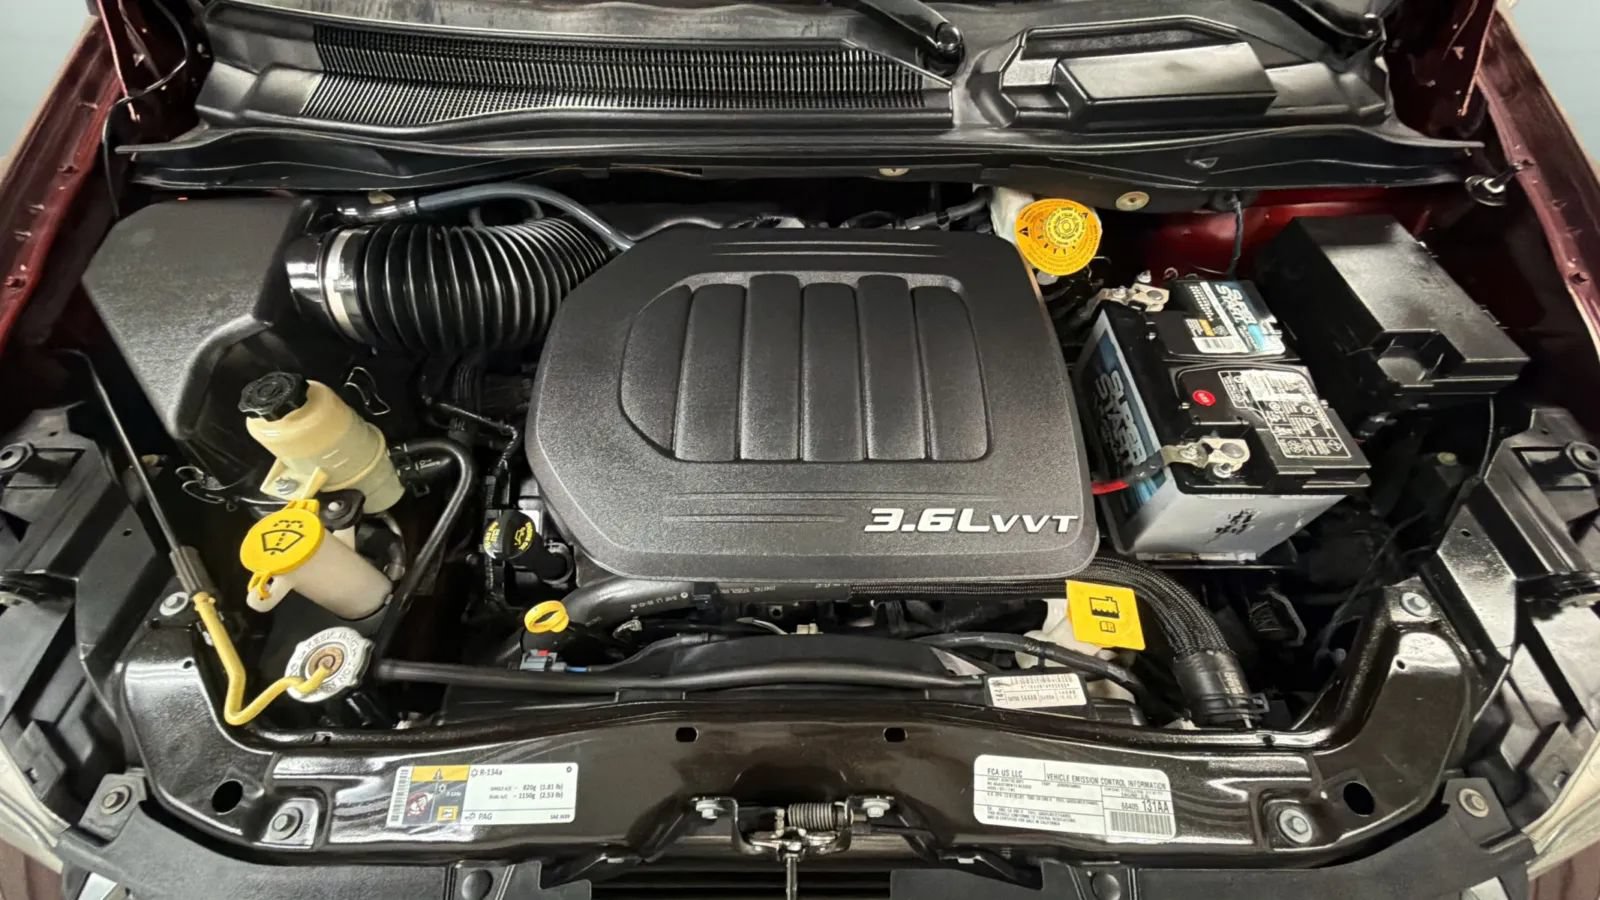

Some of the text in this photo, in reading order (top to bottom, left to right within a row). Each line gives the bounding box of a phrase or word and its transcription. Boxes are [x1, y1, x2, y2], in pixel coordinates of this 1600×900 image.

[1111, 370, 1148, 466] SUPER
[864, 508, 1079, 533] 3.6L VVT
[479, 768, 503, 776] R-134a
[987, 767, 1023, 778] FCA US LLC
[1046, 773, 1070, 783] VEHICLE
[1071, 775, 1099, 785] EMISSION
[1100, 777, 1126, 787] CONTROL
[1127, 780, 1166, 790] INFORMATION
[523, 784, 537, 792] 820g
[518, 792, 536, 800] 1150g
[1142, 799, 1170, 813] 131AA
[478, 812, 493, 820] PAG
